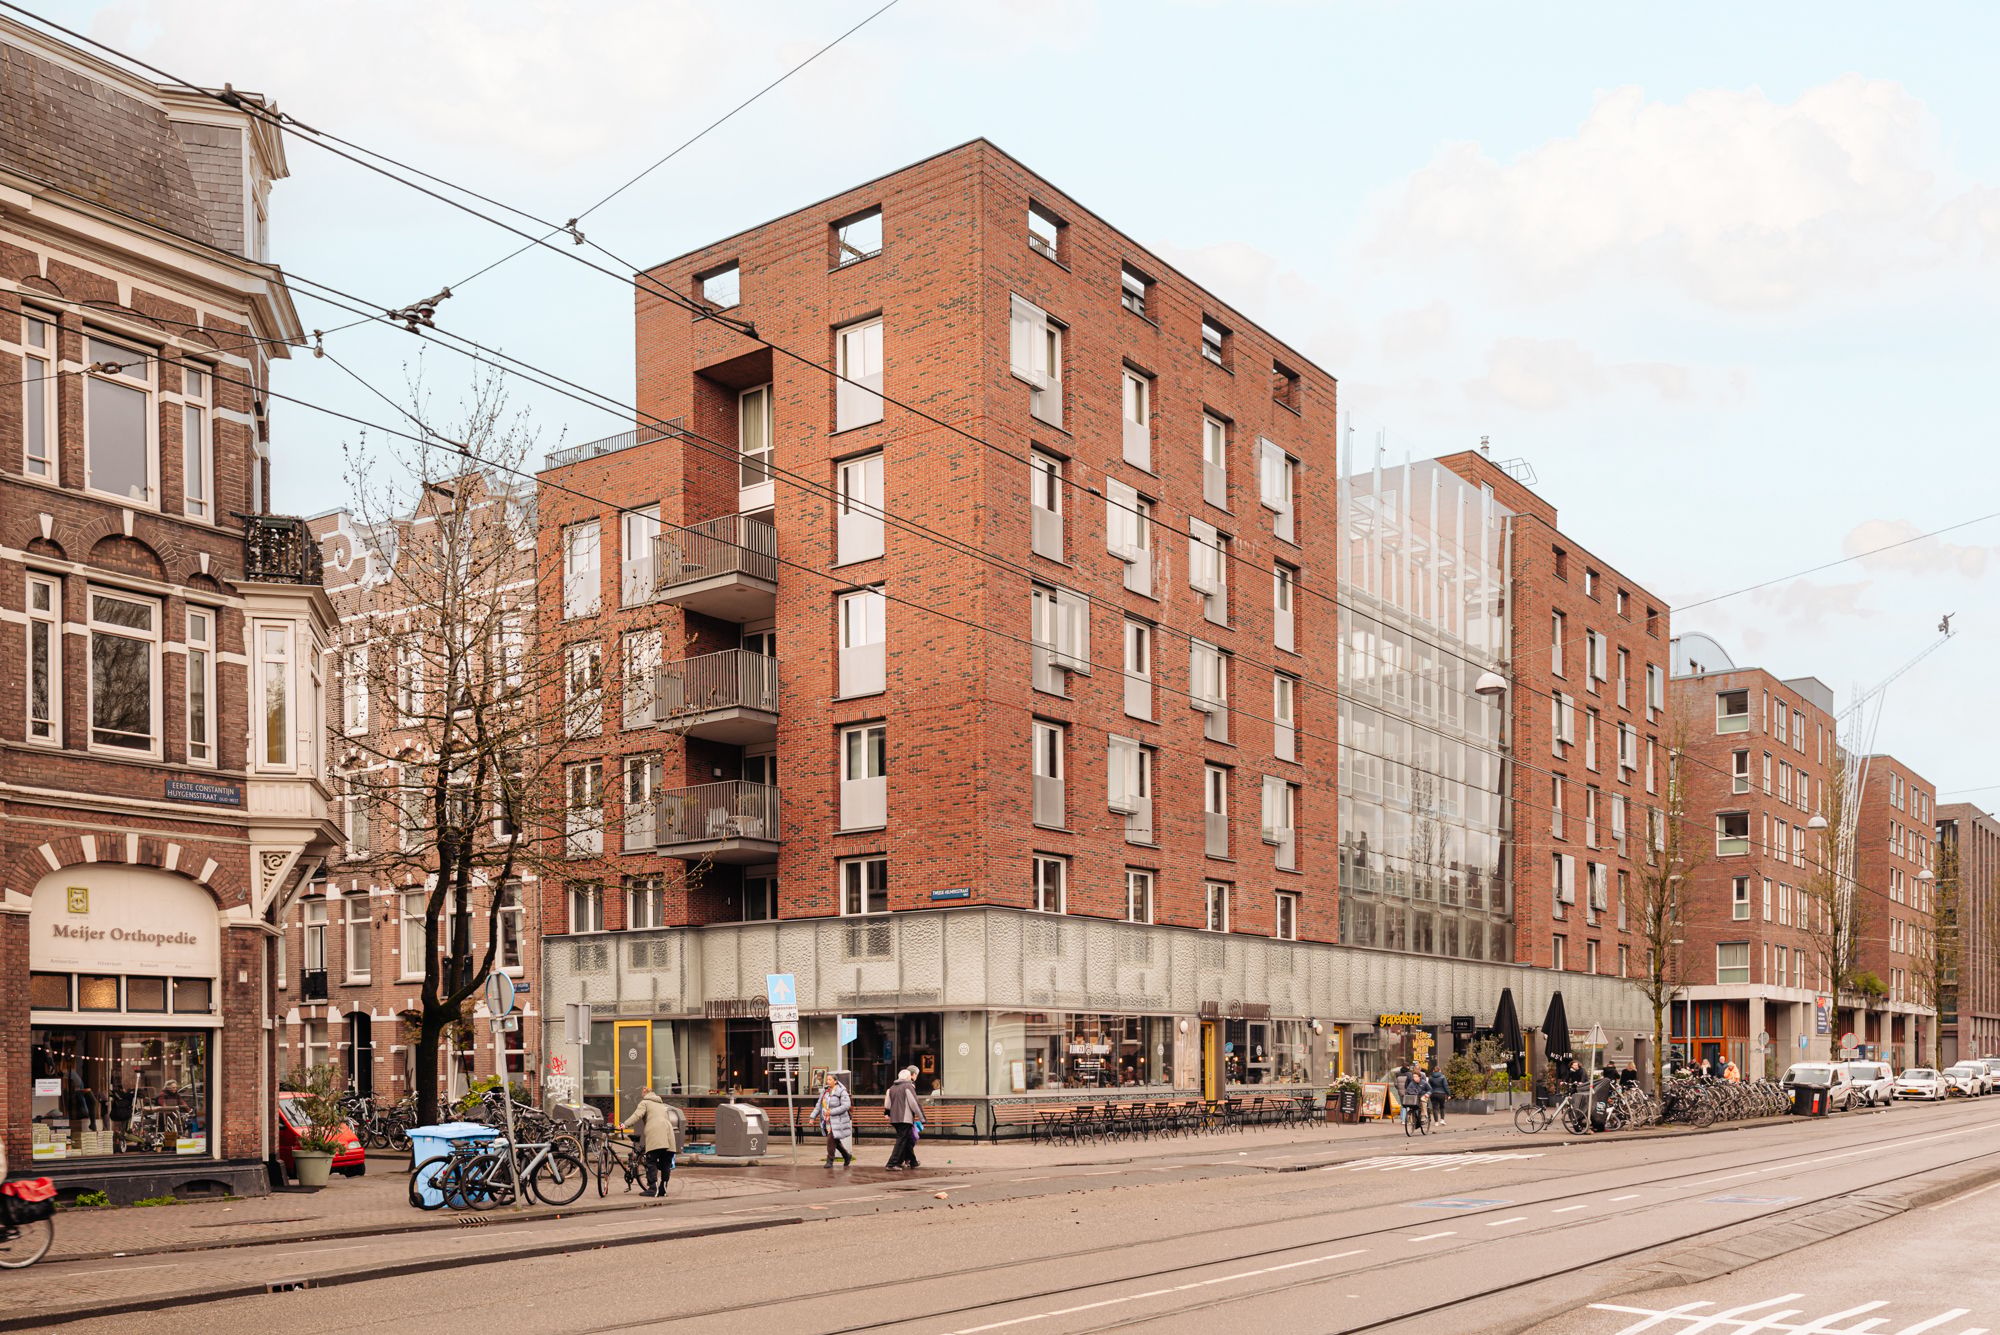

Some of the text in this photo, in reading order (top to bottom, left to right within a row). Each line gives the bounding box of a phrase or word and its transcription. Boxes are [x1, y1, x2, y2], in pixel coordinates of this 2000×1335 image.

[167, 789, 218, 801] HUYGENSSTRAAT
[172, 782, 235, 796] EERSTE CONSTANTIJN
[53, 924, 198, 947] Meijer Orthopedie
[782, 1036, 793, 1044] 30
